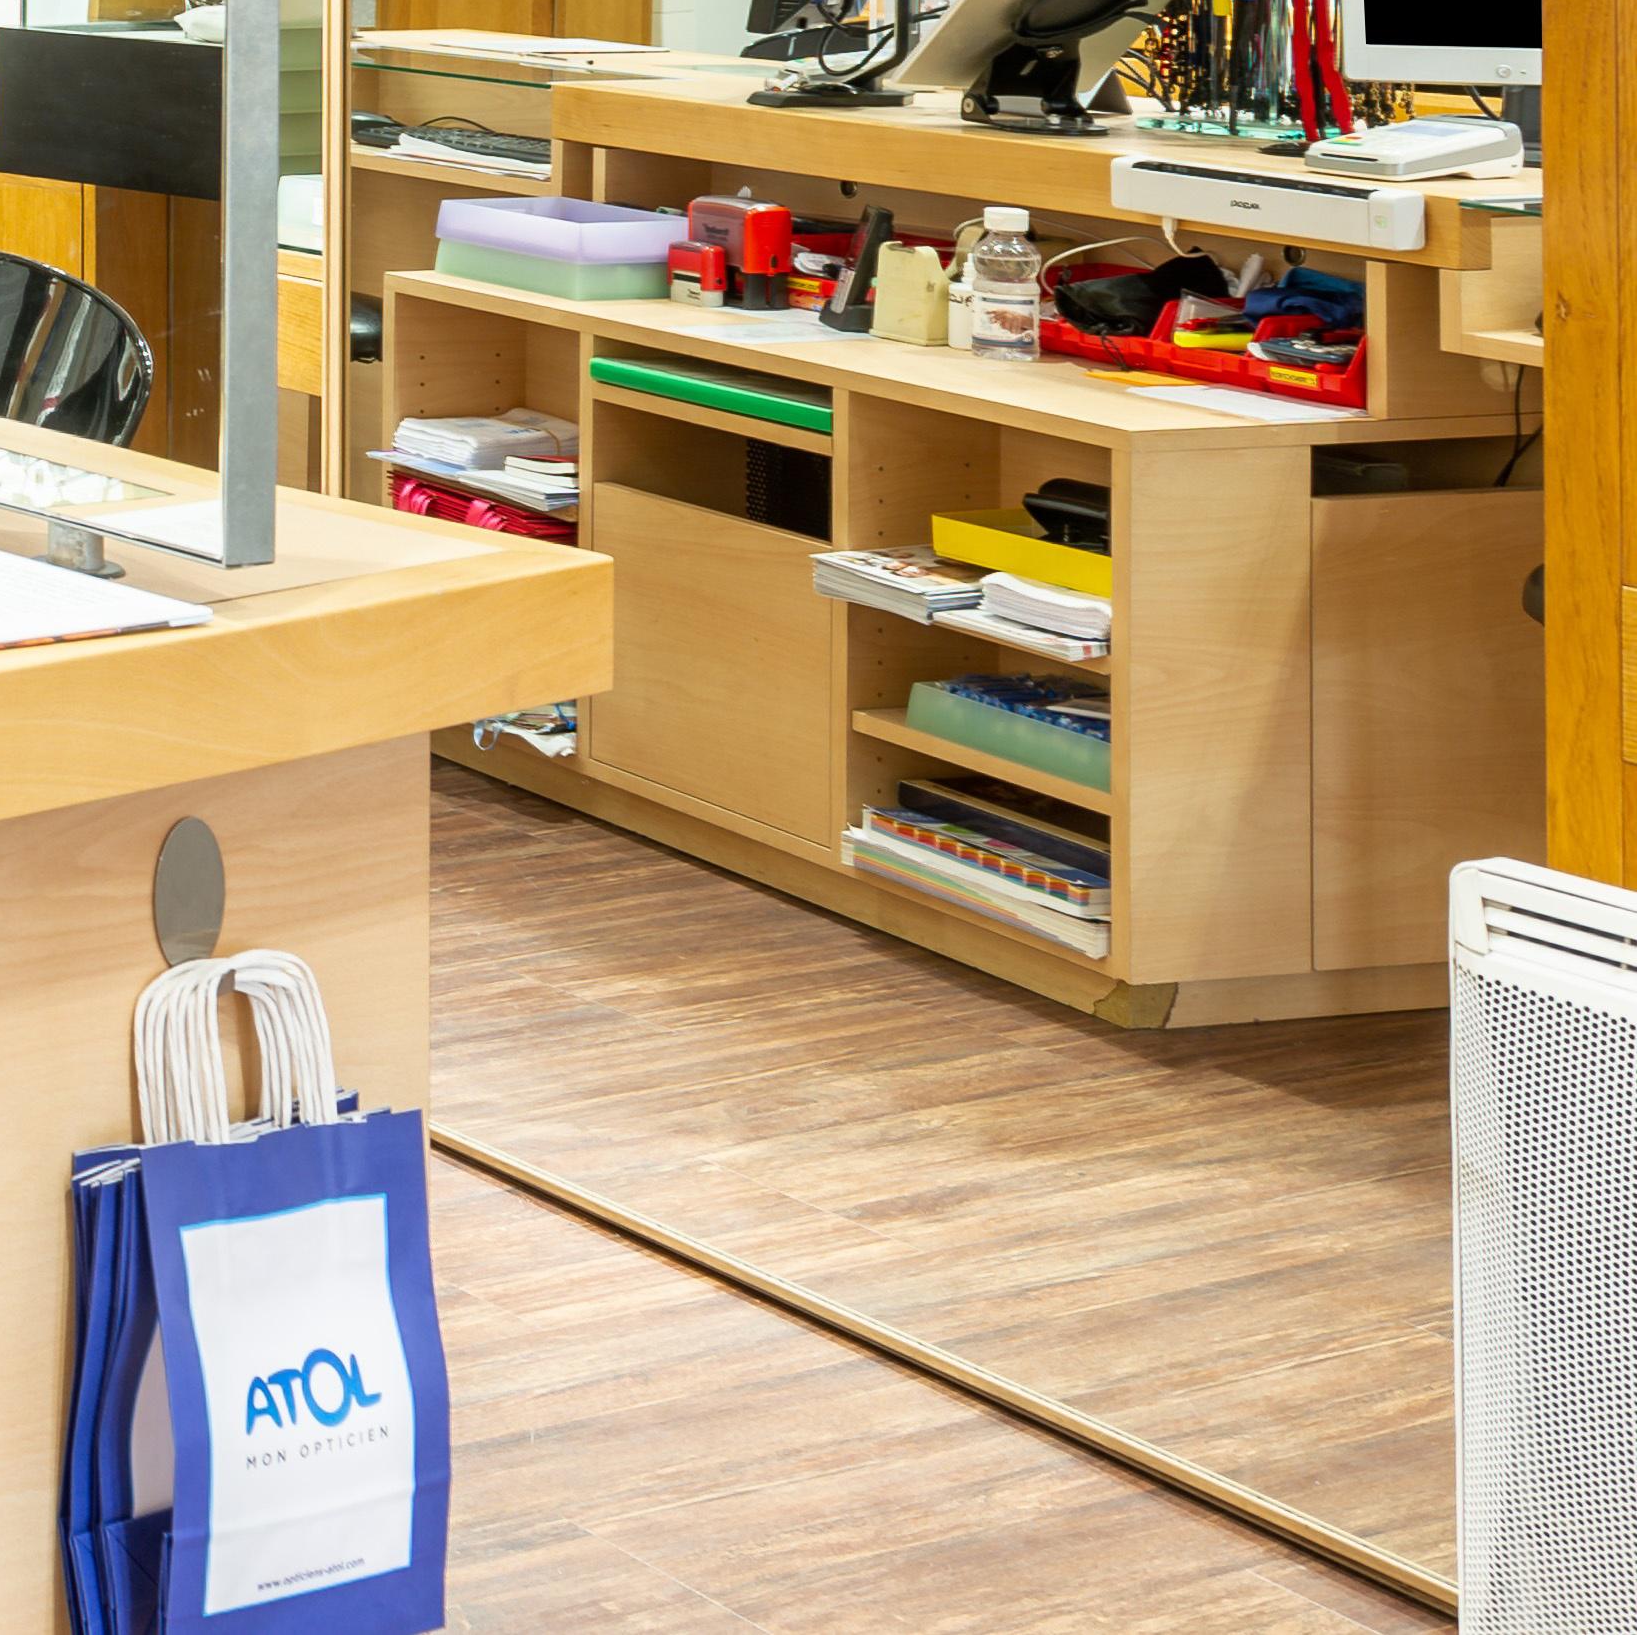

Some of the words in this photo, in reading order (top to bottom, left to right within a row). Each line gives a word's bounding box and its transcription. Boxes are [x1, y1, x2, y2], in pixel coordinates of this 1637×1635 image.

[246, 1348, 382, 1436] ATOL
[246, 1449, 287, 1470] MON
[299, 1425, 390, 1459] OPTICIEN
